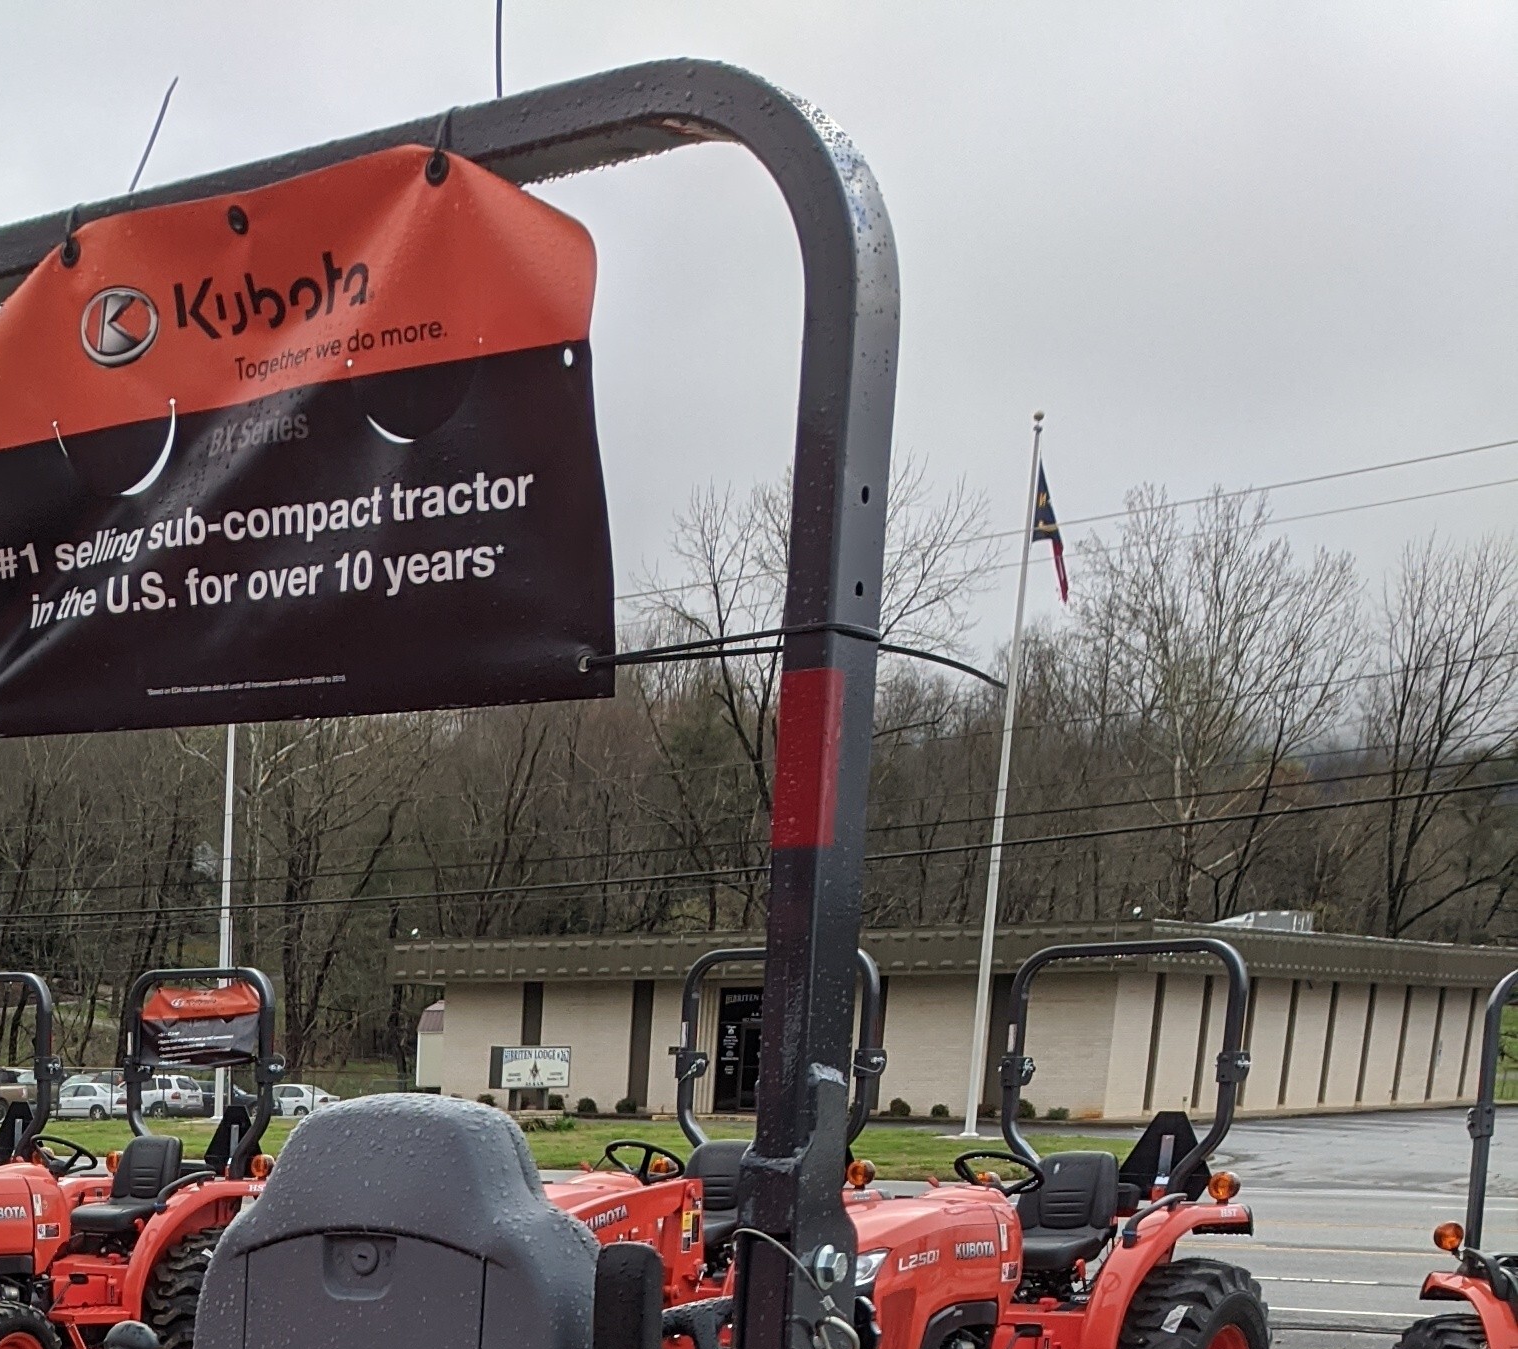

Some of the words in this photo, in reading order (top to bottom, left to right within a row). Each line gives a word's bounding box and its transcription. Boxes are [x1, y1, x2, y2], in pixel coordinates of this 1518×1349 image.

[173, 251, 371, 340] Kubota
[235, 345, 312, 382] Together
[315, 337, 342, 358] we
[347, 329, 375, 353] do
[380, 319, 448, 347] more.
[207, 425, 235, 458] BX
[239, 410, 310, 450] Series
[54, 526, 145, 573] selling
[146, 486, 383, 551] sub-compact
[390, 471, 534, 522] tractor
[29, 593, 55, 629] in
[55, 586, 97, 621] the
[106, 573, 177, 615] U.S.
[185, 567, 238, 607] for
[247, 563, 324, 601] over
[335, 549, 373, 593] 10
[955, 1241, 996, 1261] KUBOTA
